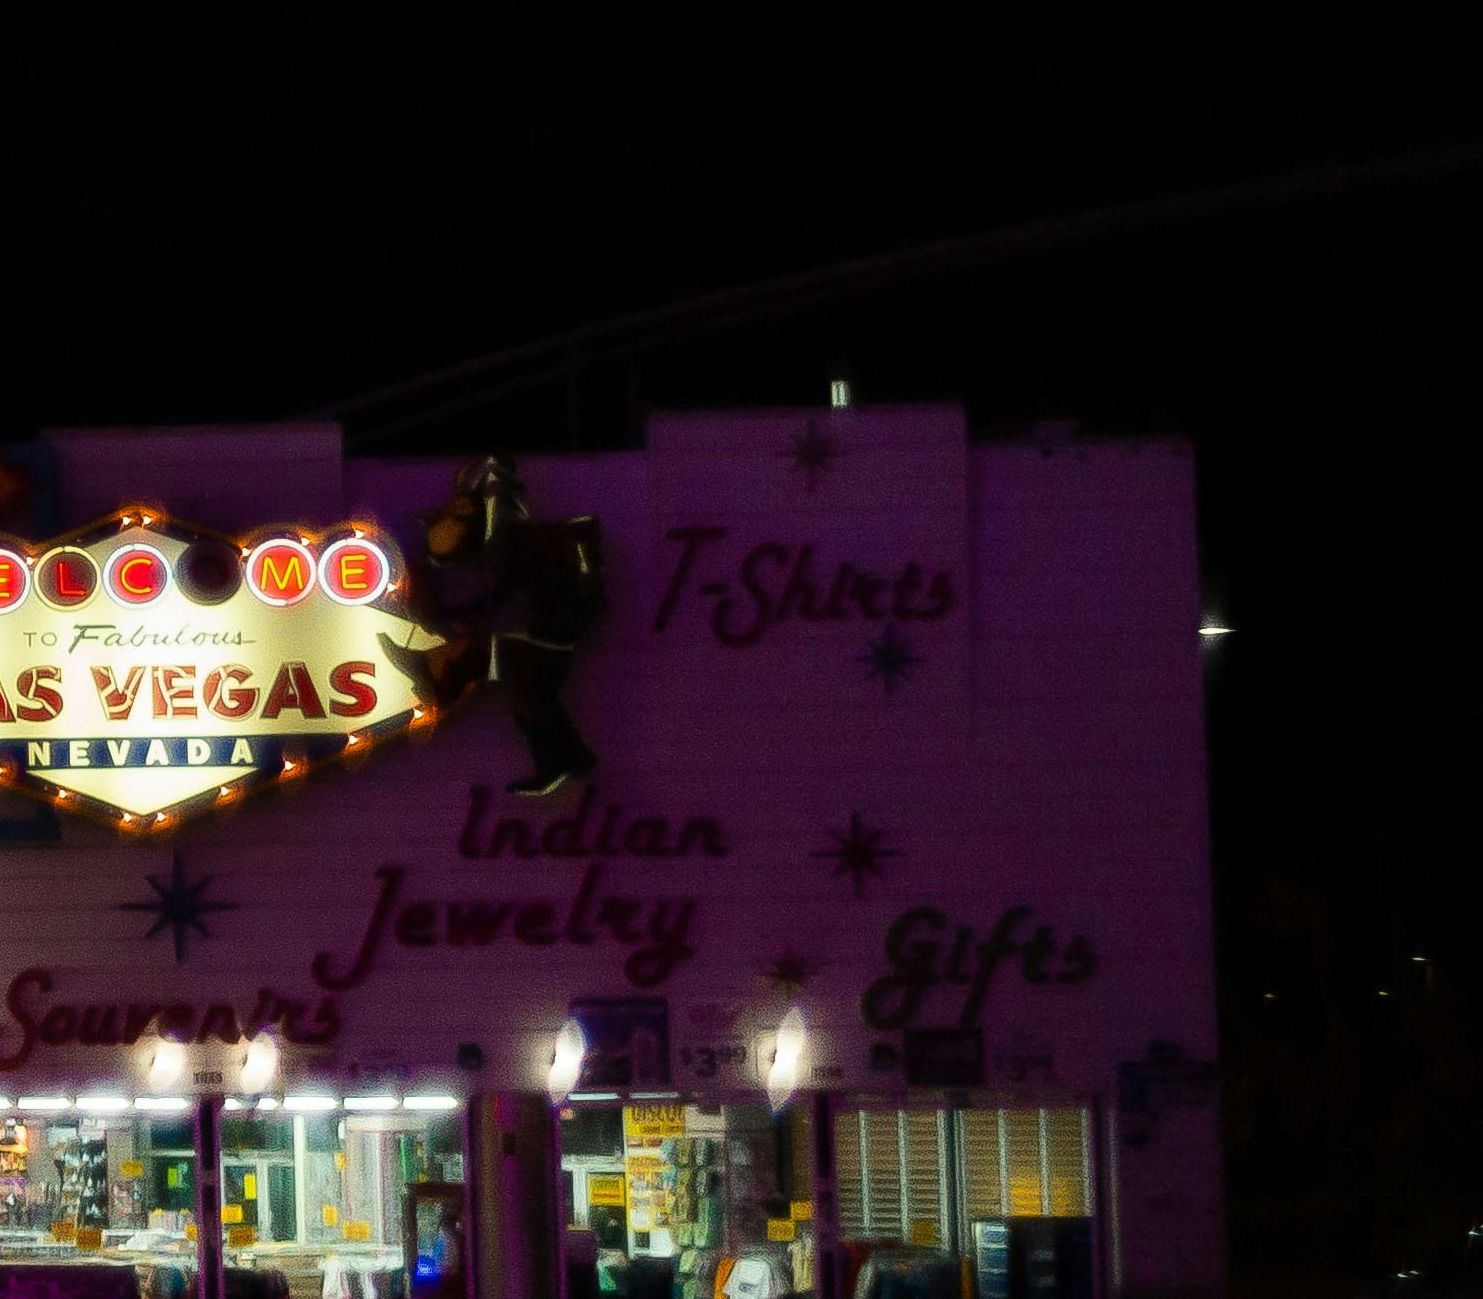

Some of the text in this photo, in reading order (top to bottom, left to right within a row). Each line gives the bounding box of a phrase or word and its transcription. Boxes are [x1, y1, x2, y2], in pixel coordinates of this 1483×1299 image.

[653, 527, 957, 648] T-Shirts
[22, 623, 256, 654] TO Fabulous
[90, 660, 379, 722] VEGAS
[26, 738, 254, 768] NEVADA
[457, 783, 728, 859] Indian
[861, 906, 1098, 1031] Gifts
